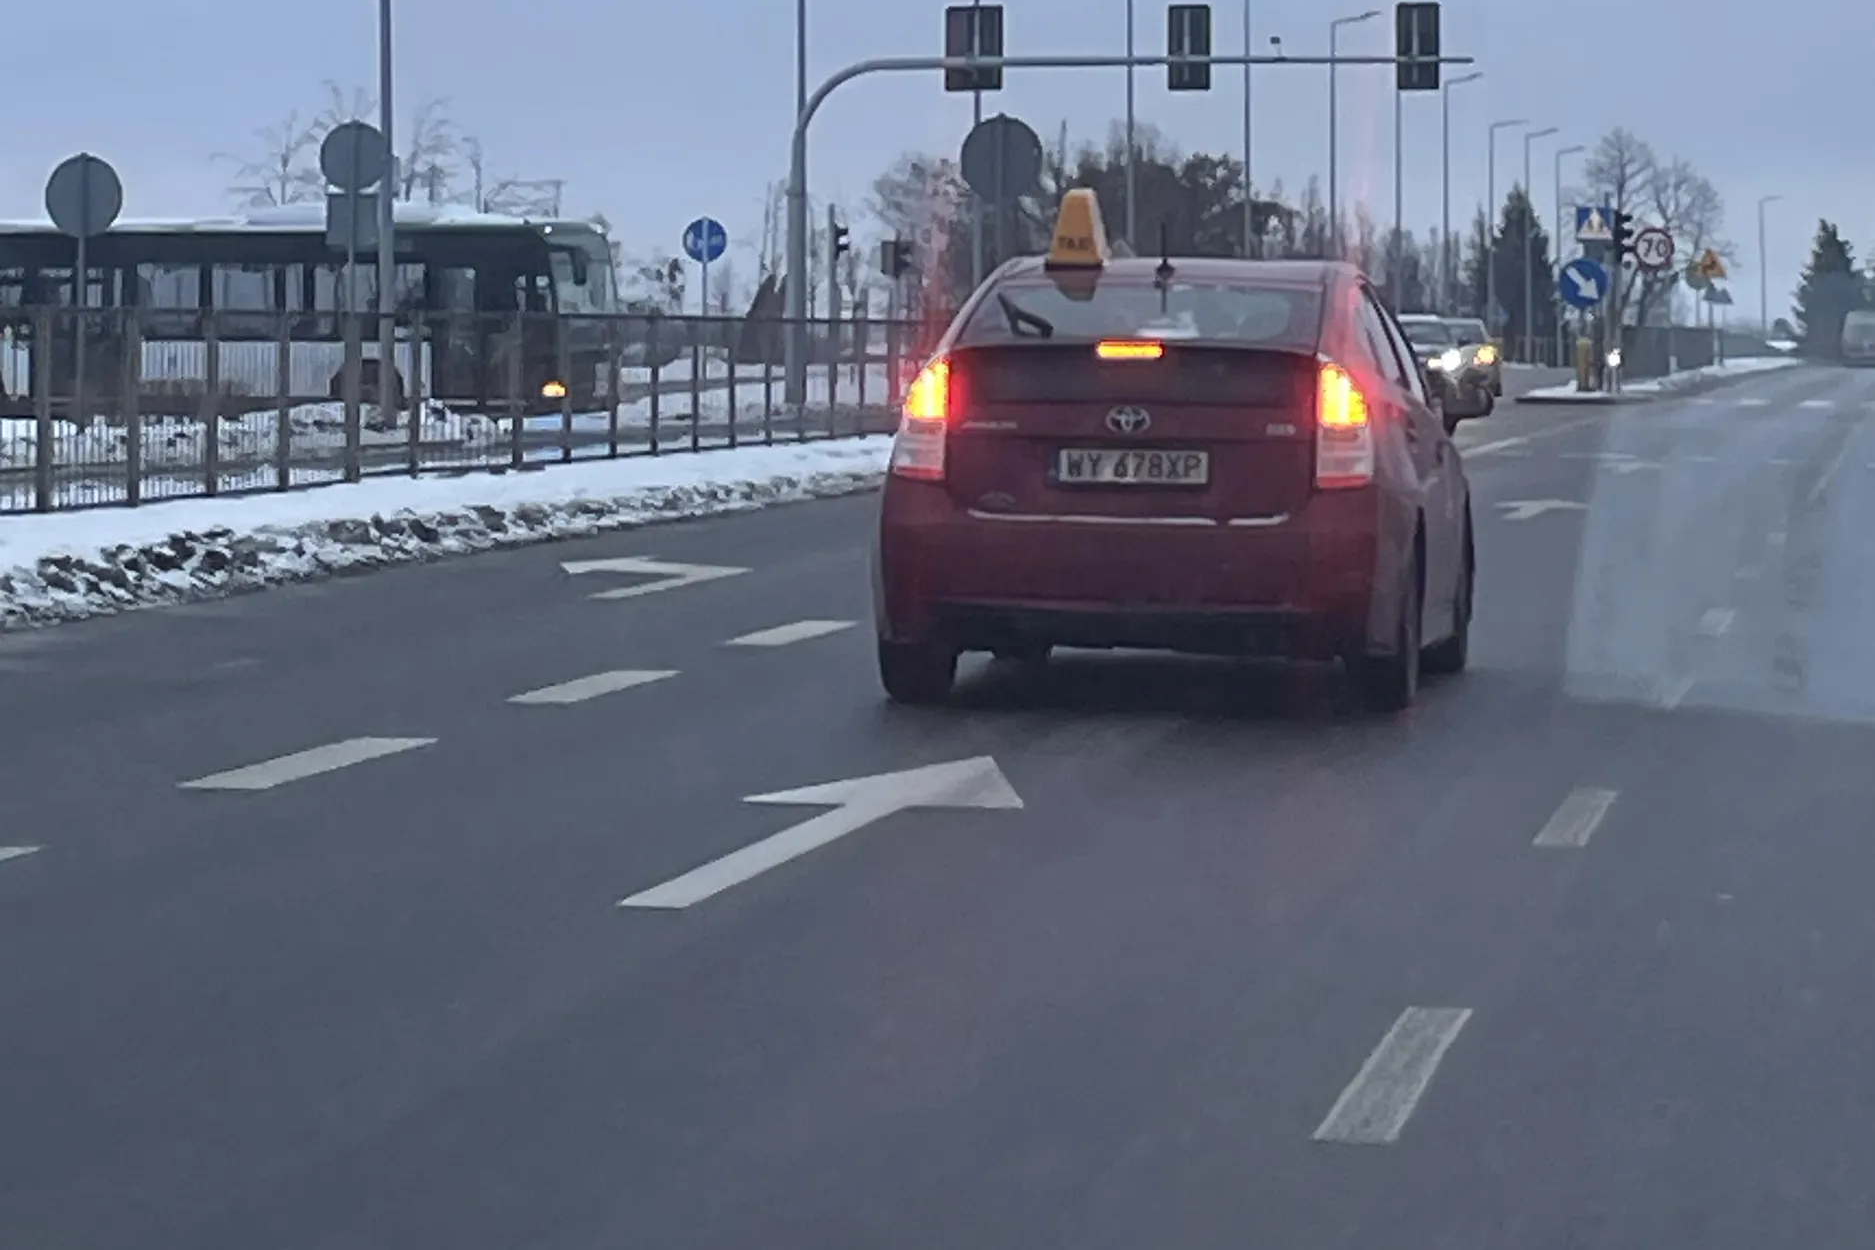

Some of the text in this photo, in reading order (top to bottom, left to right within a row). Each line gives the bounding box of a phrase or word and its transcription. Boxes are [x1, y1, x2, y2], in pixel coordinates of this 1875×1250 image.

[1642, 237, 1669, 258] 70
[1067, 452, 1202, 479] WY 678XP
